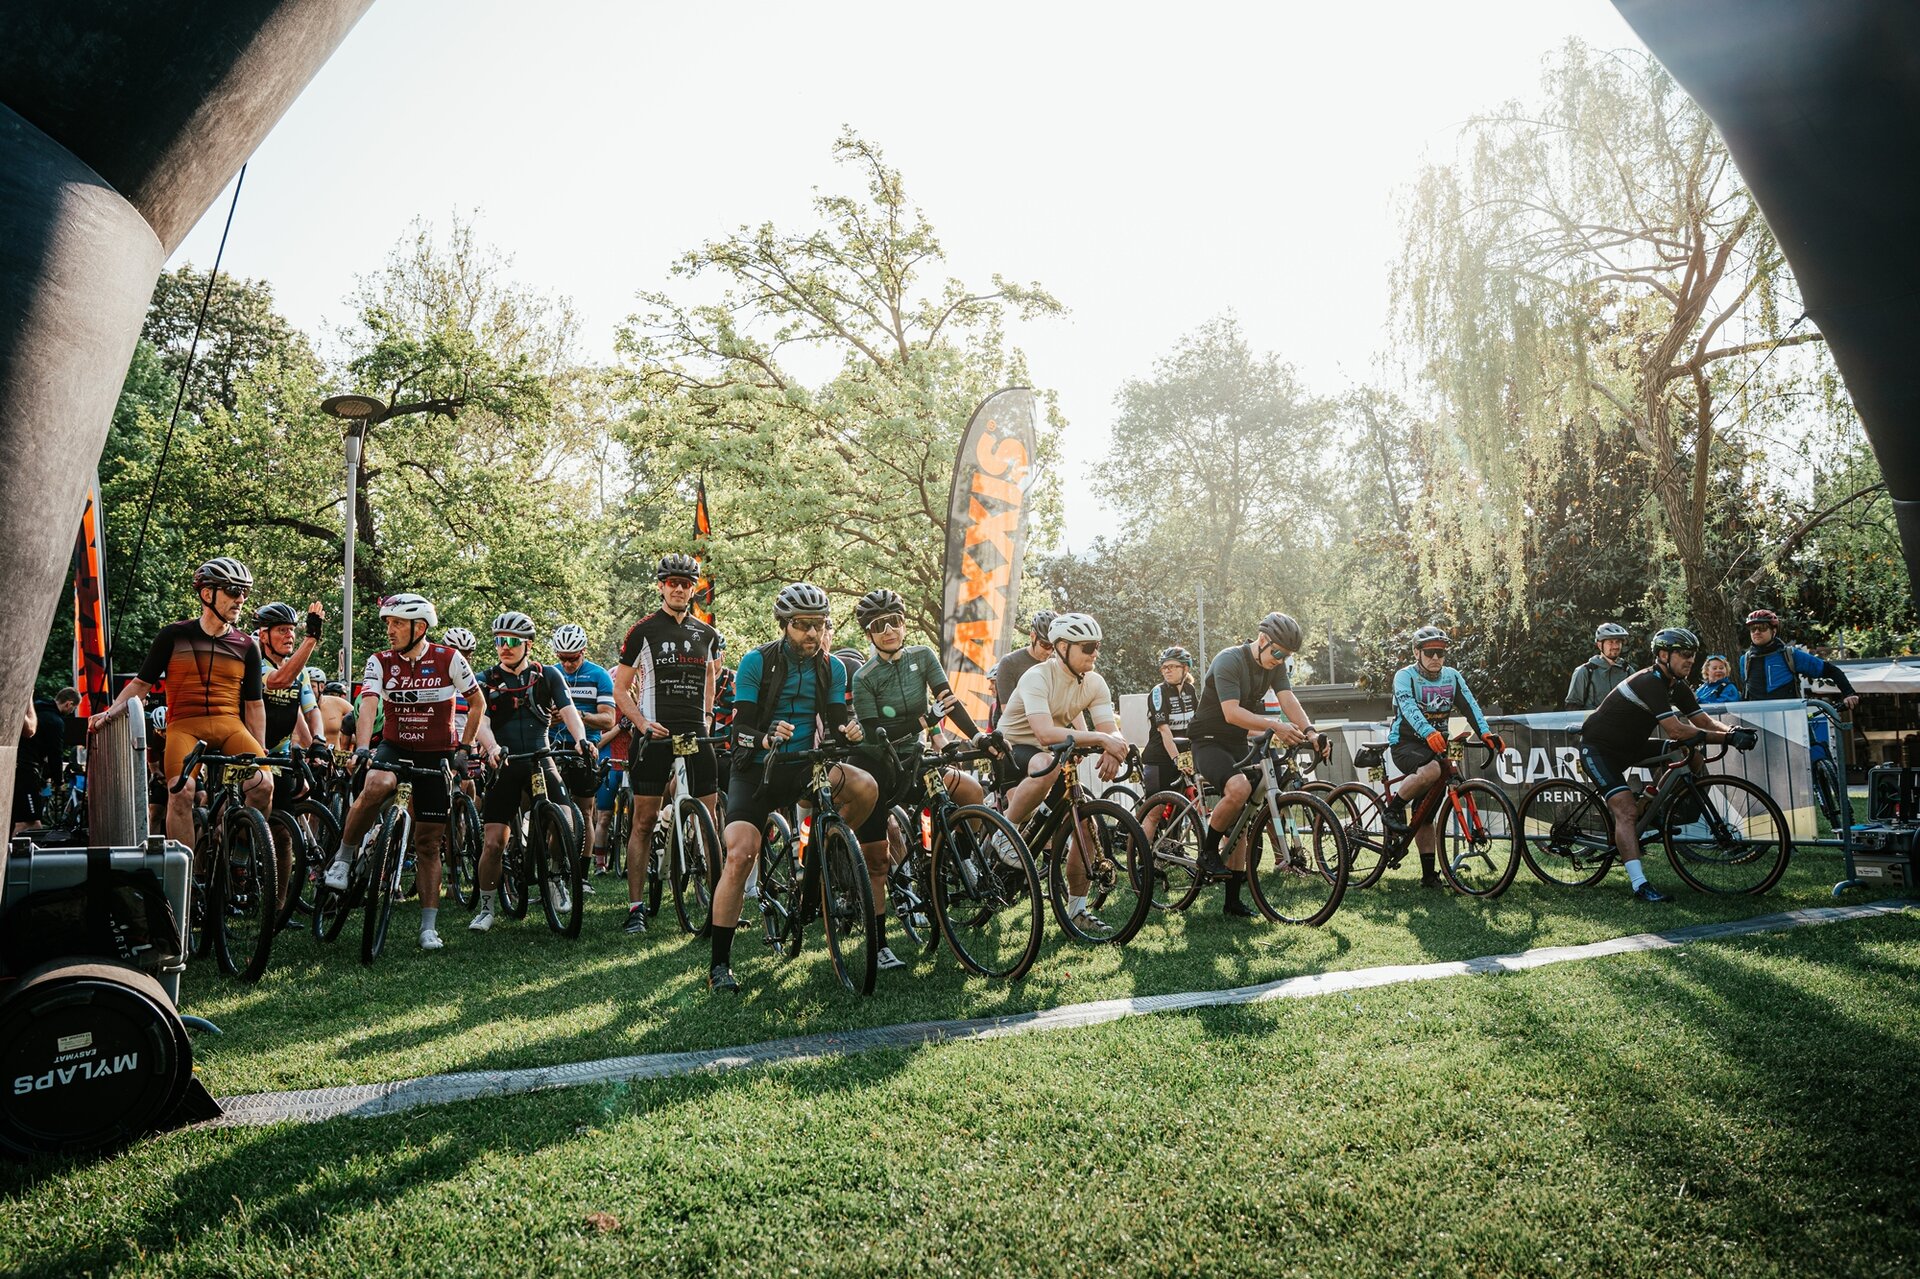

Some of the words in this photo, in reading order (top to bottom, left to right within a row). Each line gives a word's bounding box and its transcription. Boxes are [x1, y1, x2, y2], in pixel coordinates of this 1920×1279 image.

[944, 432, 1029, 738] MAXXIS
[400, 677, 442, 689] FACTOR
[1496, 746, 1654, 785] GARA
[14, 1052, 139, 1095] MYLAPS
[54, 1048, 97, 1064] EASYMAT
